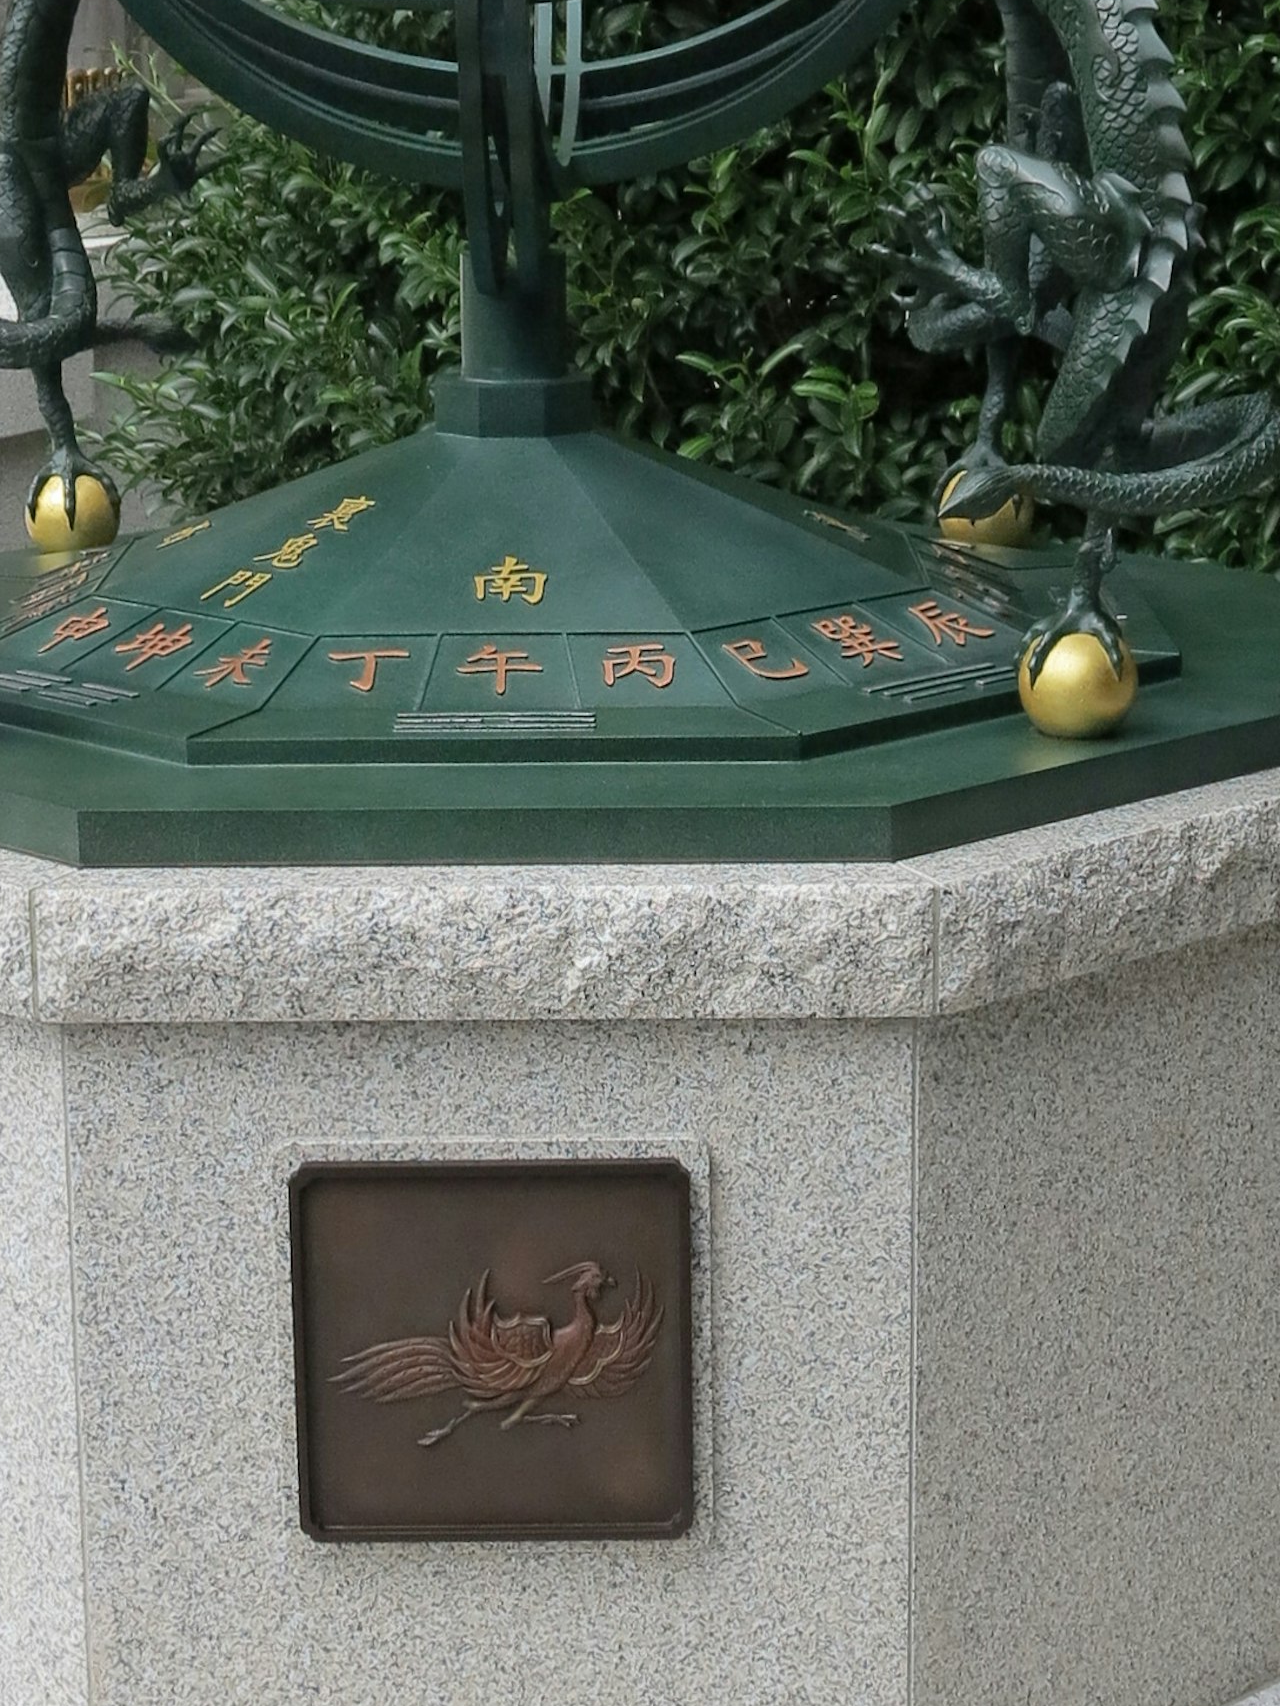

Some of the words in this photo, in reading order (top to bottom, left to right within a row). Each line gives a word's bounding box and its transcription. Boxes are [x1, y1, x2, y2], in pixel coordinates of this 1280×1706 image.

[473, 555, 548, 605] 南
[37, 607, 111, 655] 申
[115, 623, 194, 672] 坤
[809, 614, 905, 668] 巽
[908, 600, 996, 646] 辰
[193, 638, 273, 688] 未
[327, 648, 411, 692] 丁
[456, 643, 544, 696] 午
[602, 643, 676, 688] 丙
